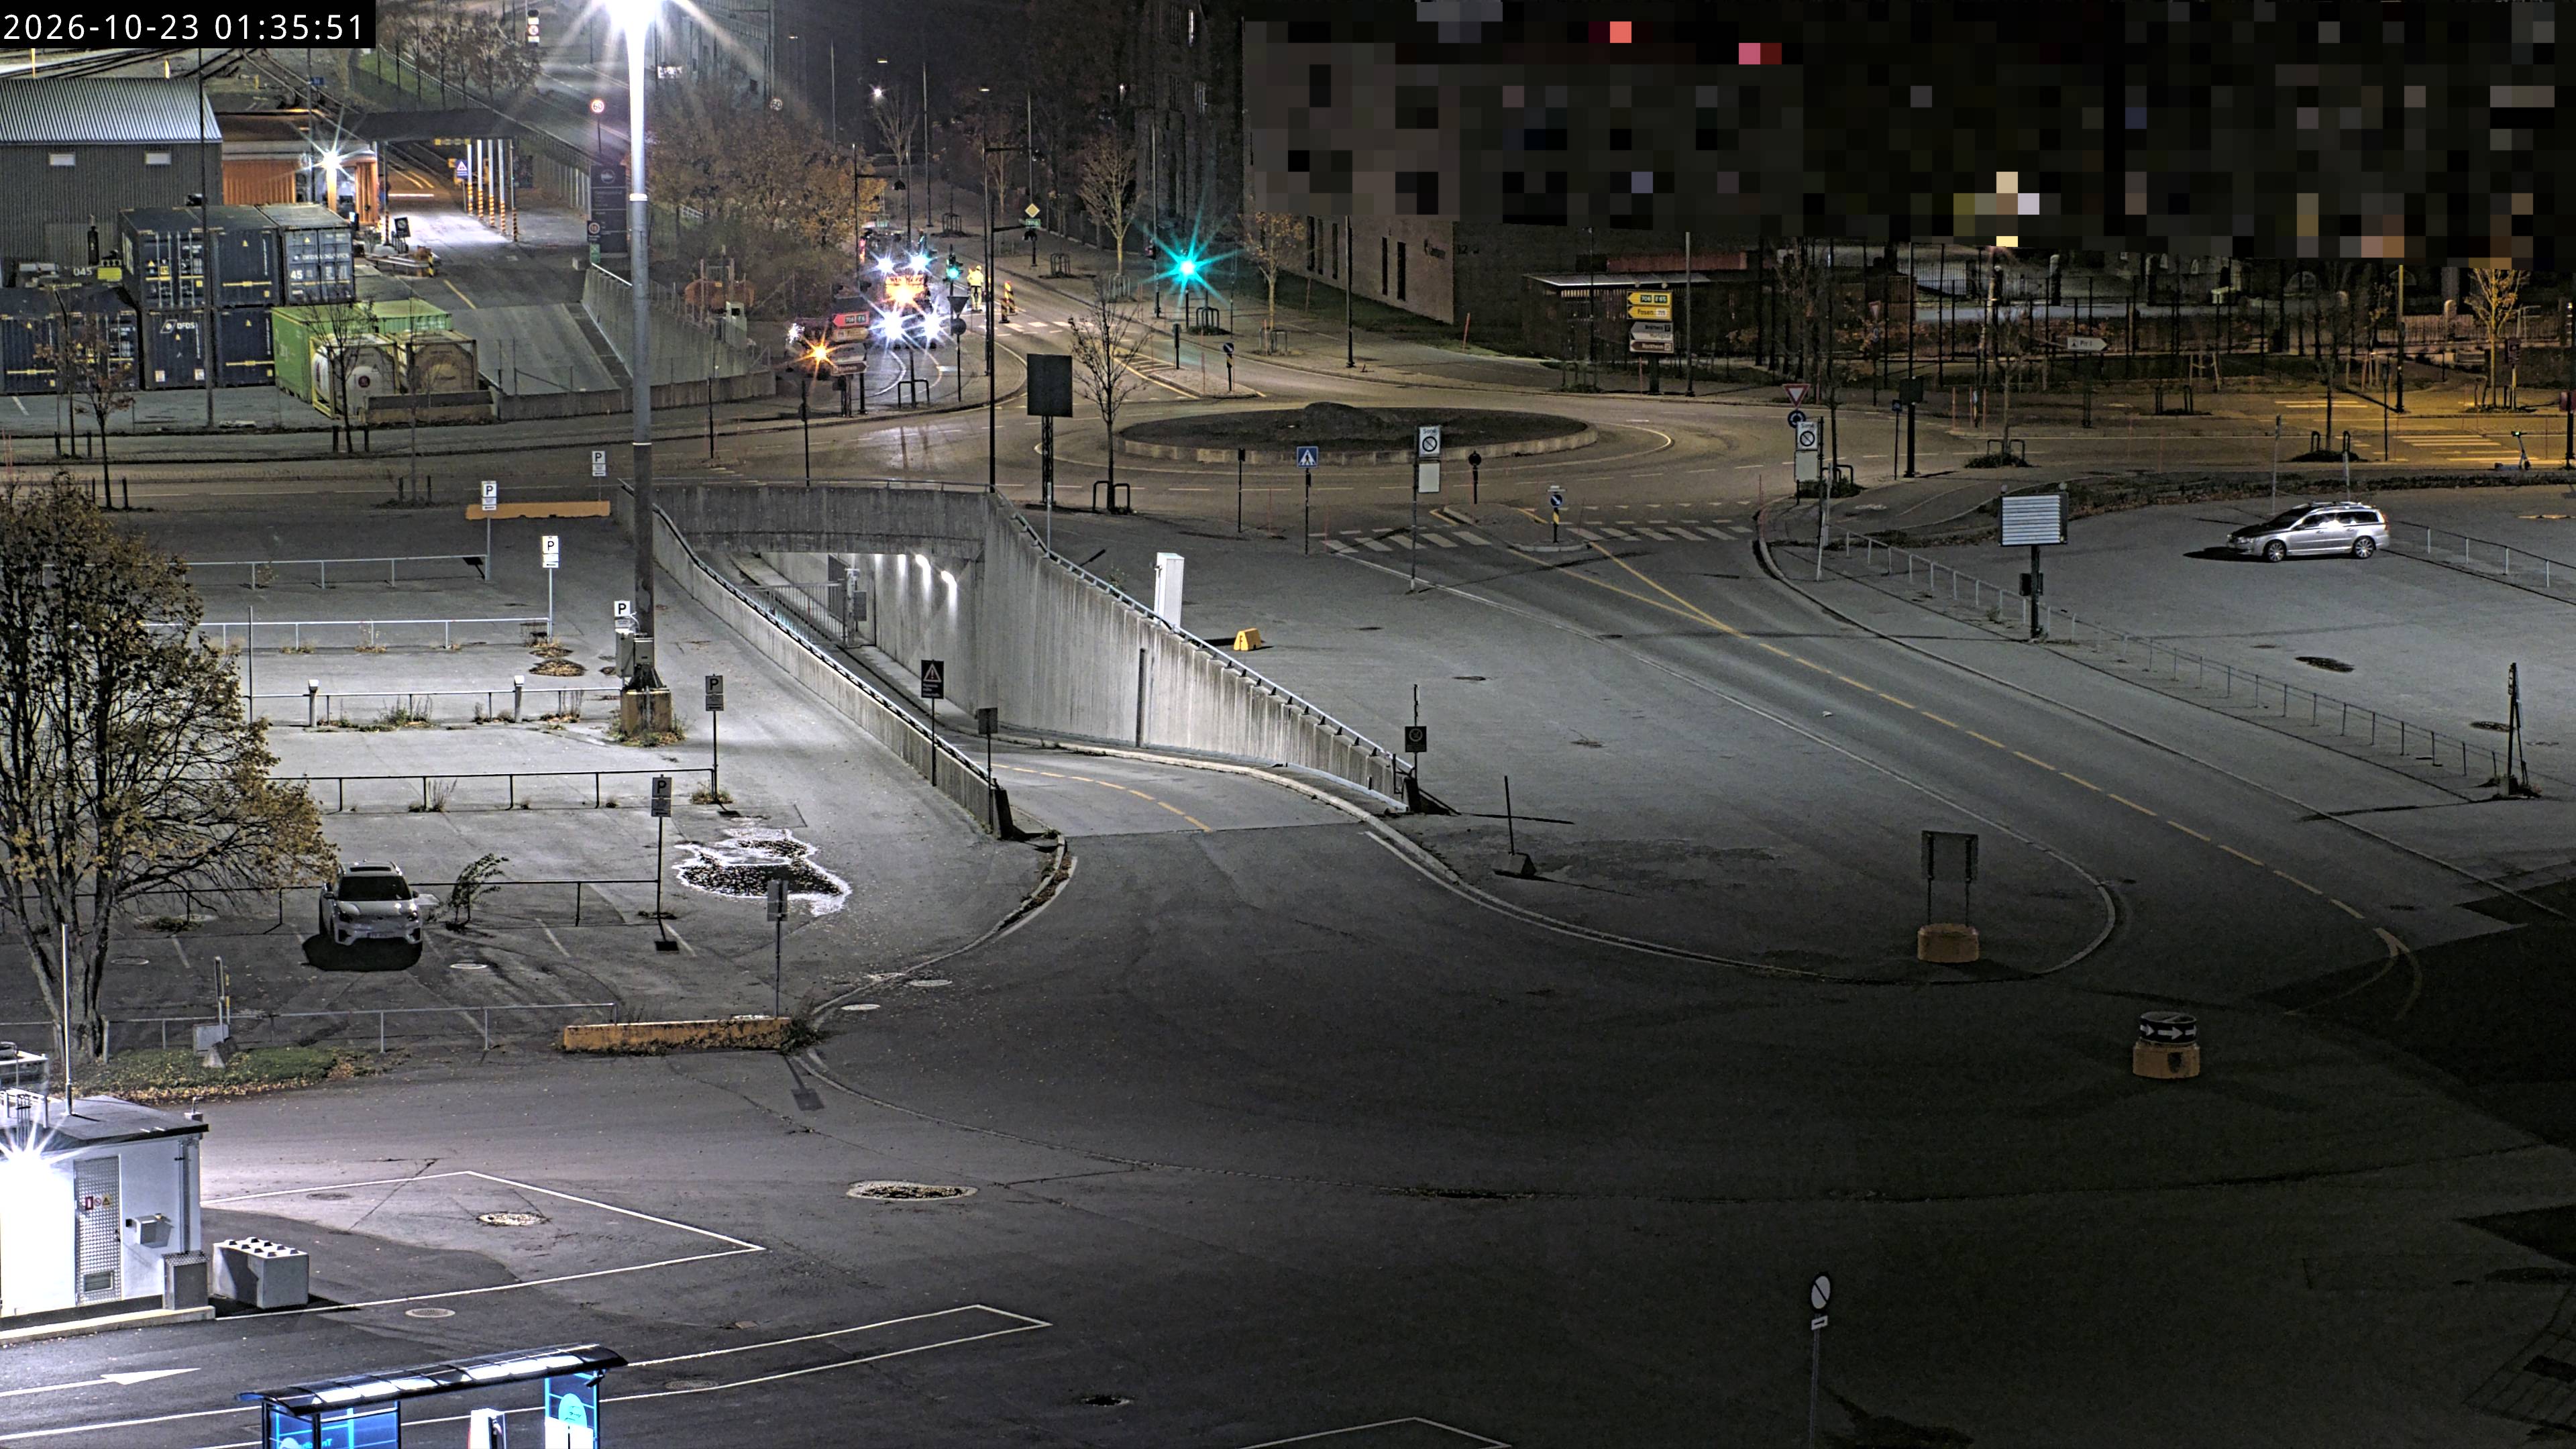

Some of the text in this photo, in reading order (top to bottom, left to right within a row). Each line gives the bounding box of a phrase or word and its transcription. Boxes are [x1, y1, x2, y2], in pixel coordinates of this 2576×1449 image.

[290, 270, 303, 279] 45
[595, 452, 602, 462] P
[486, 485, 493, 495] P
[547, 541, 554, 551] P
[619, 603, 627, 614] P
[710, 678, 718, 690] P
[657, 780, 667, 794] P
